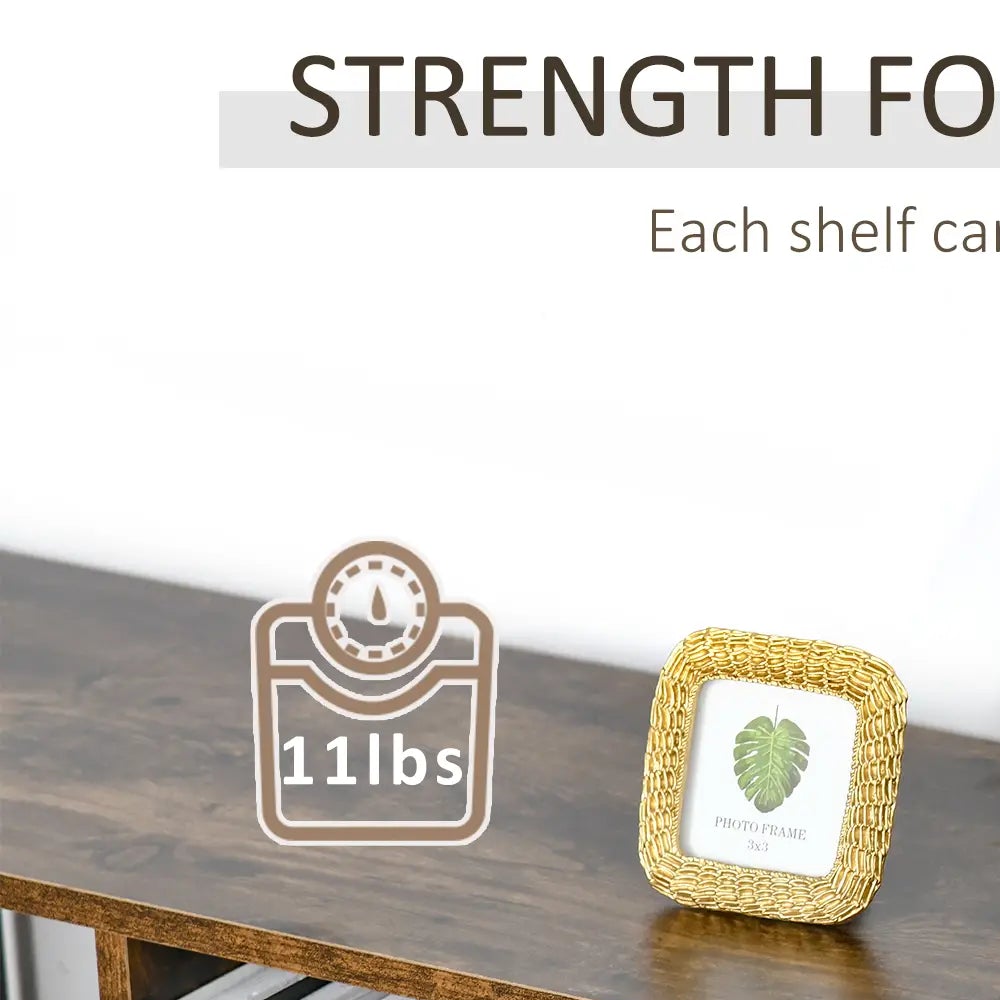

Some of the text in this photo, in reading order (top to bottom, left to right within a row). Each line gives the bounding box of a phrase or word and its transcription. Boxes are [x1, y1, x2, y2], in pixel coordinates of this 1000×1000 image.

[715, 816, 807, 841] PHOTO FRAME
[747, 839, 769, 852] 3x3
